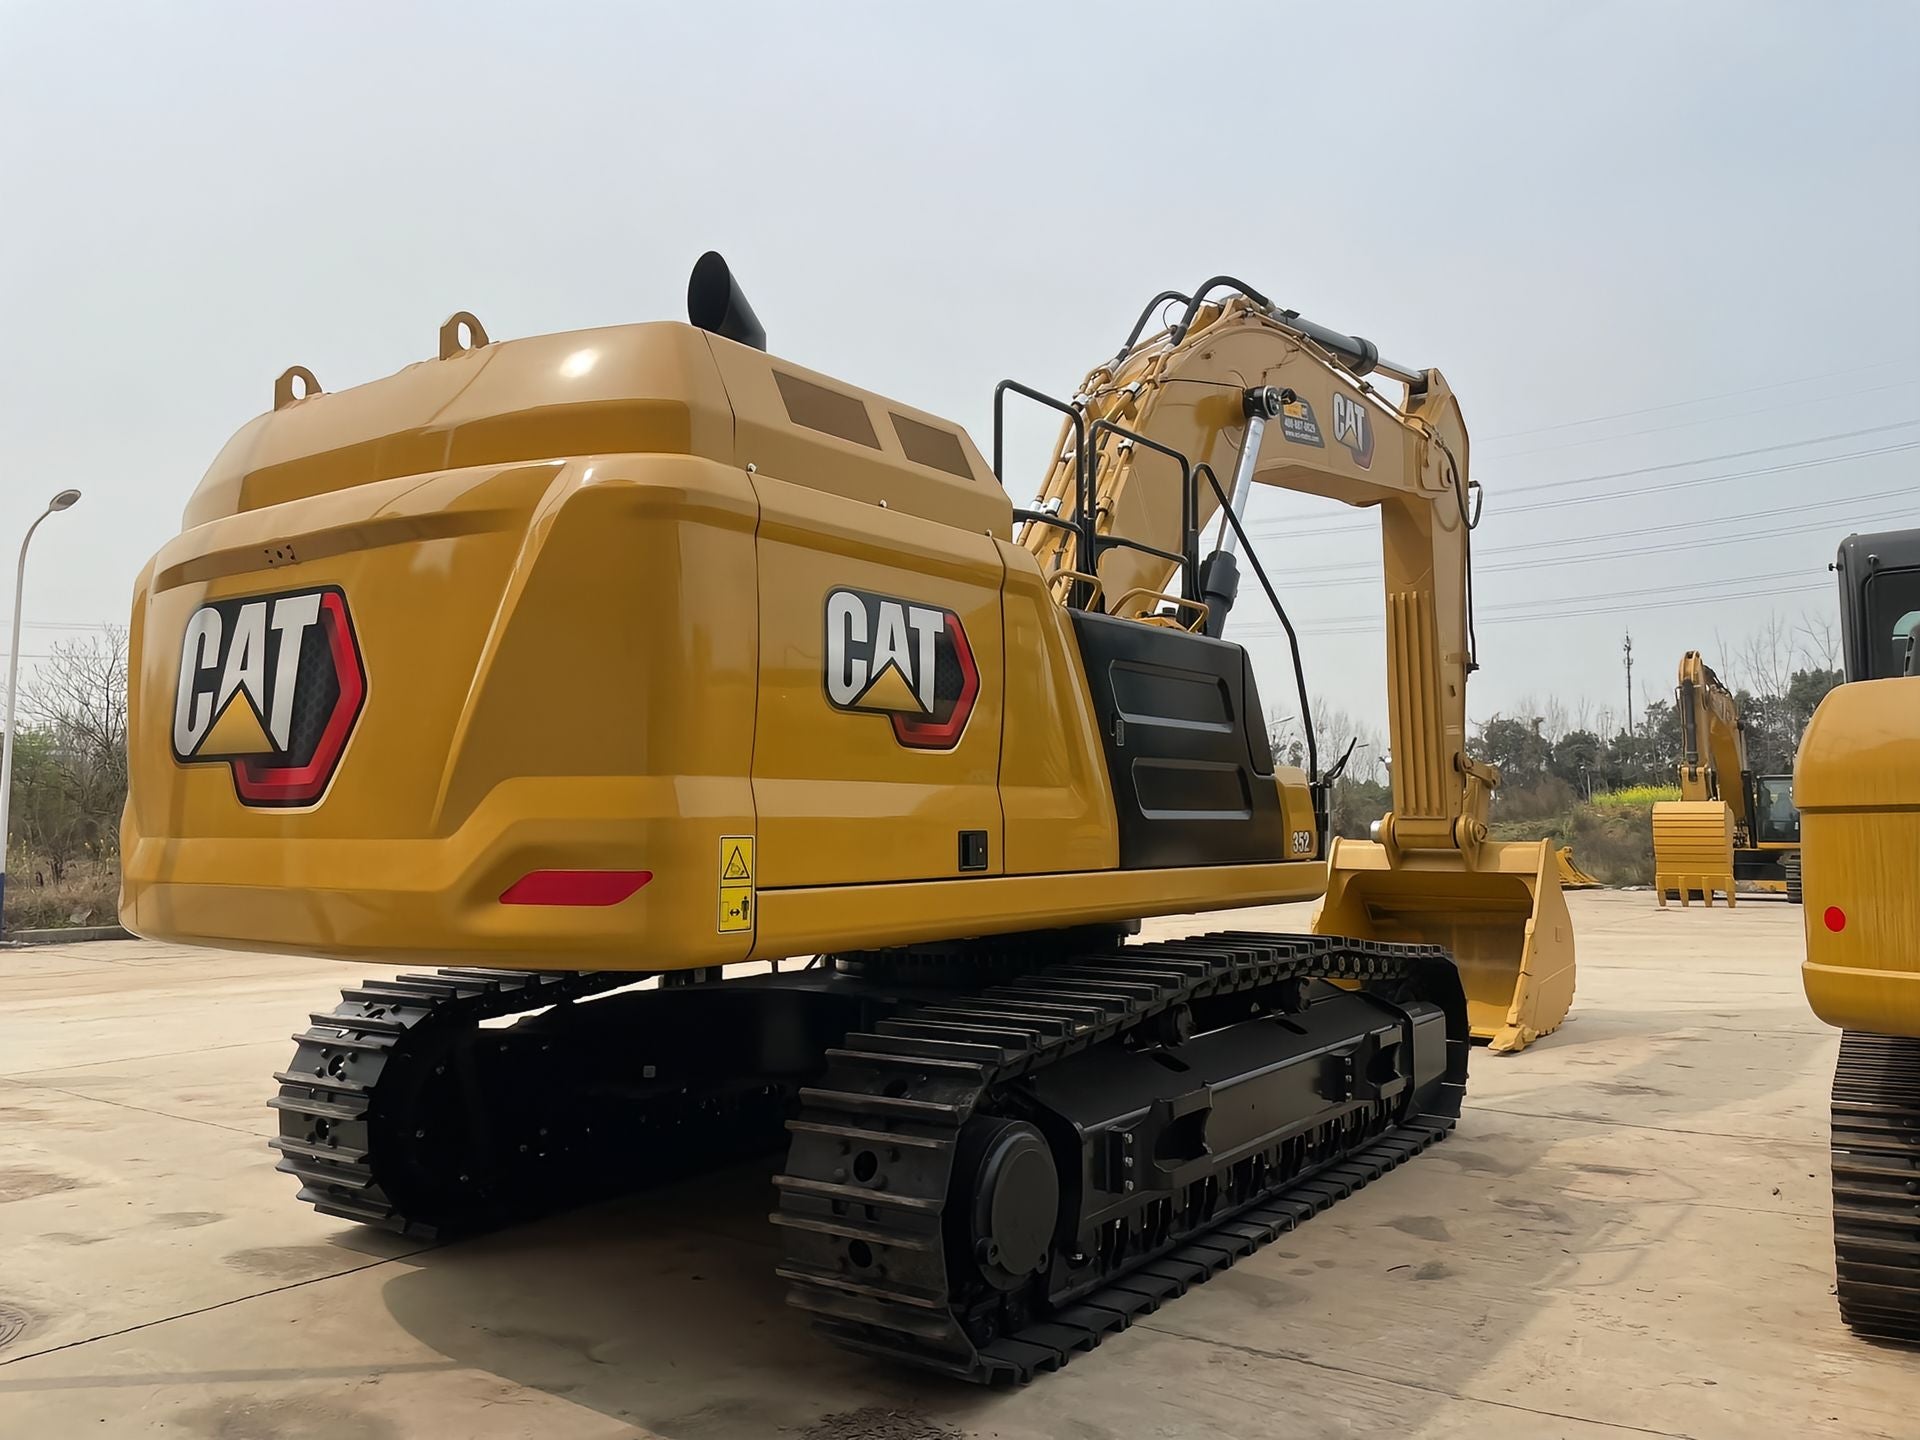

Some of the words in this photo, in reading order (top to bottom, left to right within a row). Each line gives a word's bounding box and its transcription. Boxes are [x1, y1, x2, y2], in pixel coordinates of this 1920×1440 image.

[1333, 393, 1365, 452] CAT
[174, 593, 322, 756] CAT
[827, 591, 944, 713] CAT
[1292, 831, 1310, 852] 352
